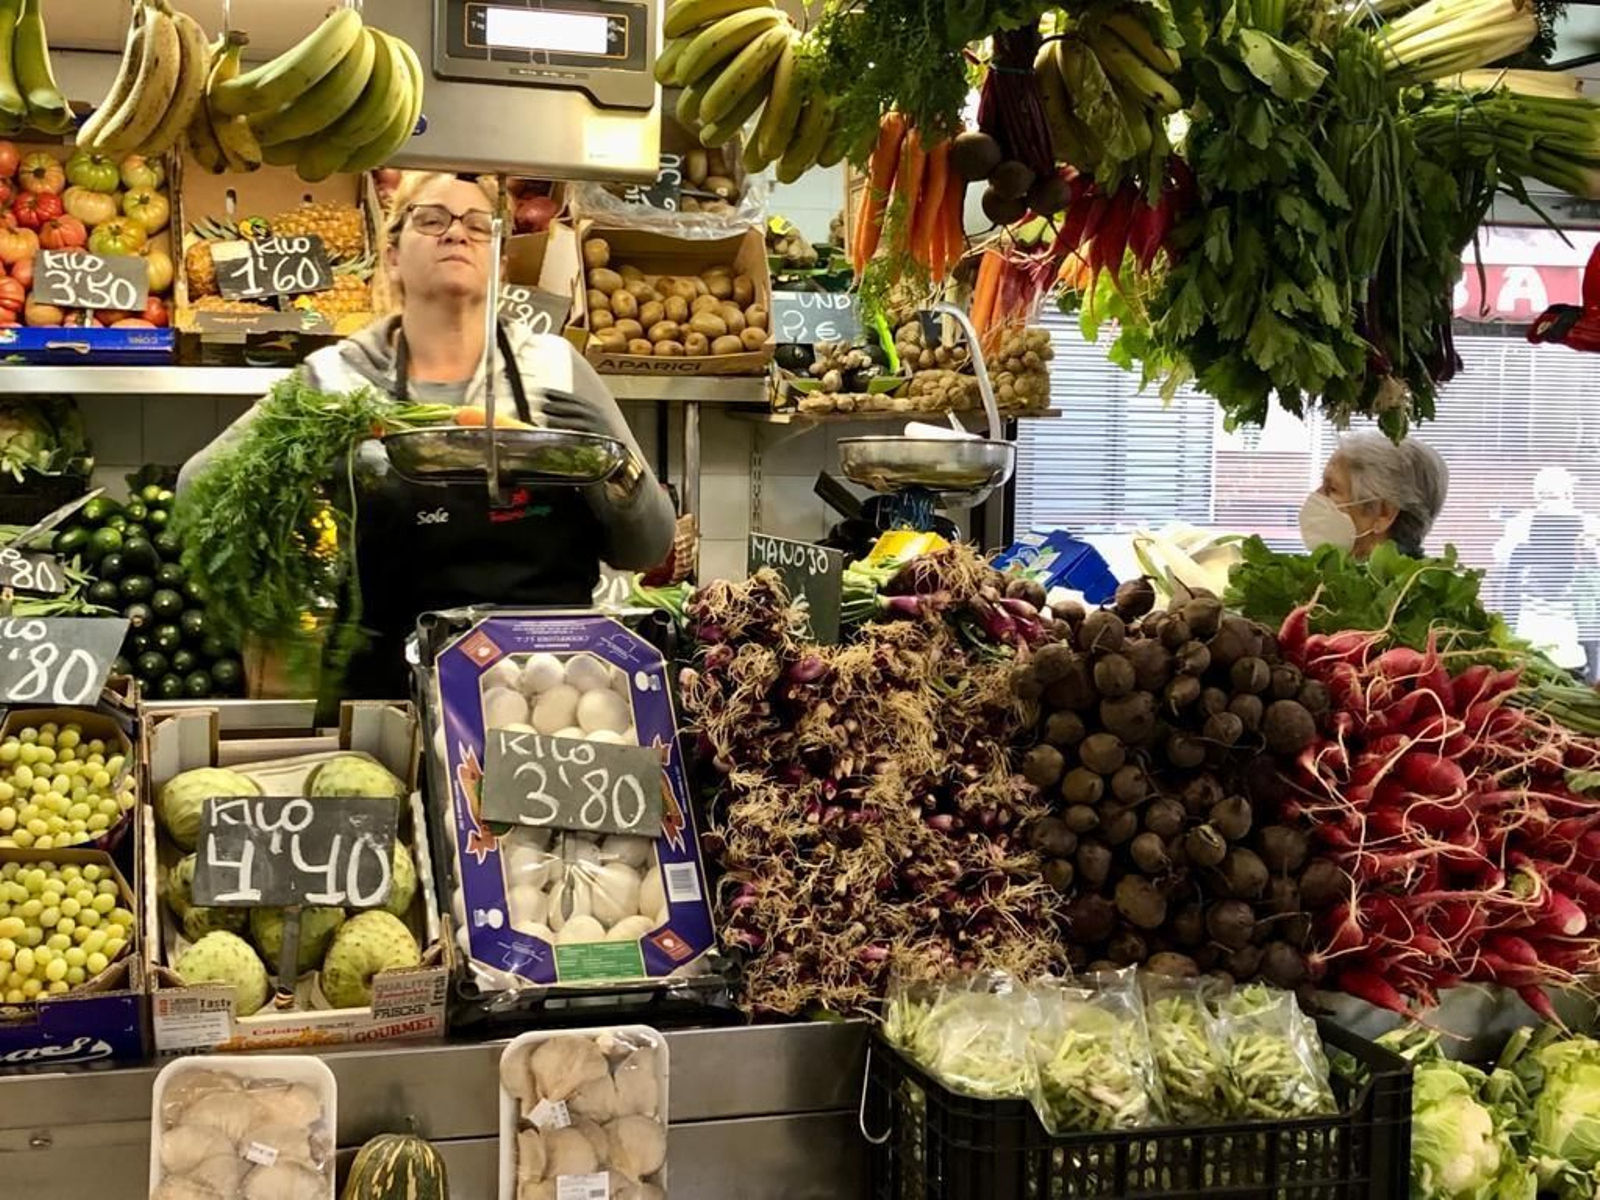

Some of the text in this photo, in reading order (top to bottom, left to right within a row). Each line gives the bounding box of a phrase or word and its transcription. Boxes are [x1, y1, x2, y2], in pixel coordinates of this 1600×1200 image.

[252, 236, 311, 256] KILO
[44, 269, 137, 310] 3'50
[230, 256, 320, 294] 1'60
[598, 359, 701, 371] APARICI
[416, 506, 449, 526] Sole
[0, 641, 99, 706] '80
[500, 731, 596, 765] KILO
[512, 761, 647, 829] 3'80
[210, 797, 314, 834] KILO
[373, 1003, 426, 1020] FRISCHE
[354, 1017, 435, 1042] GOURMET
